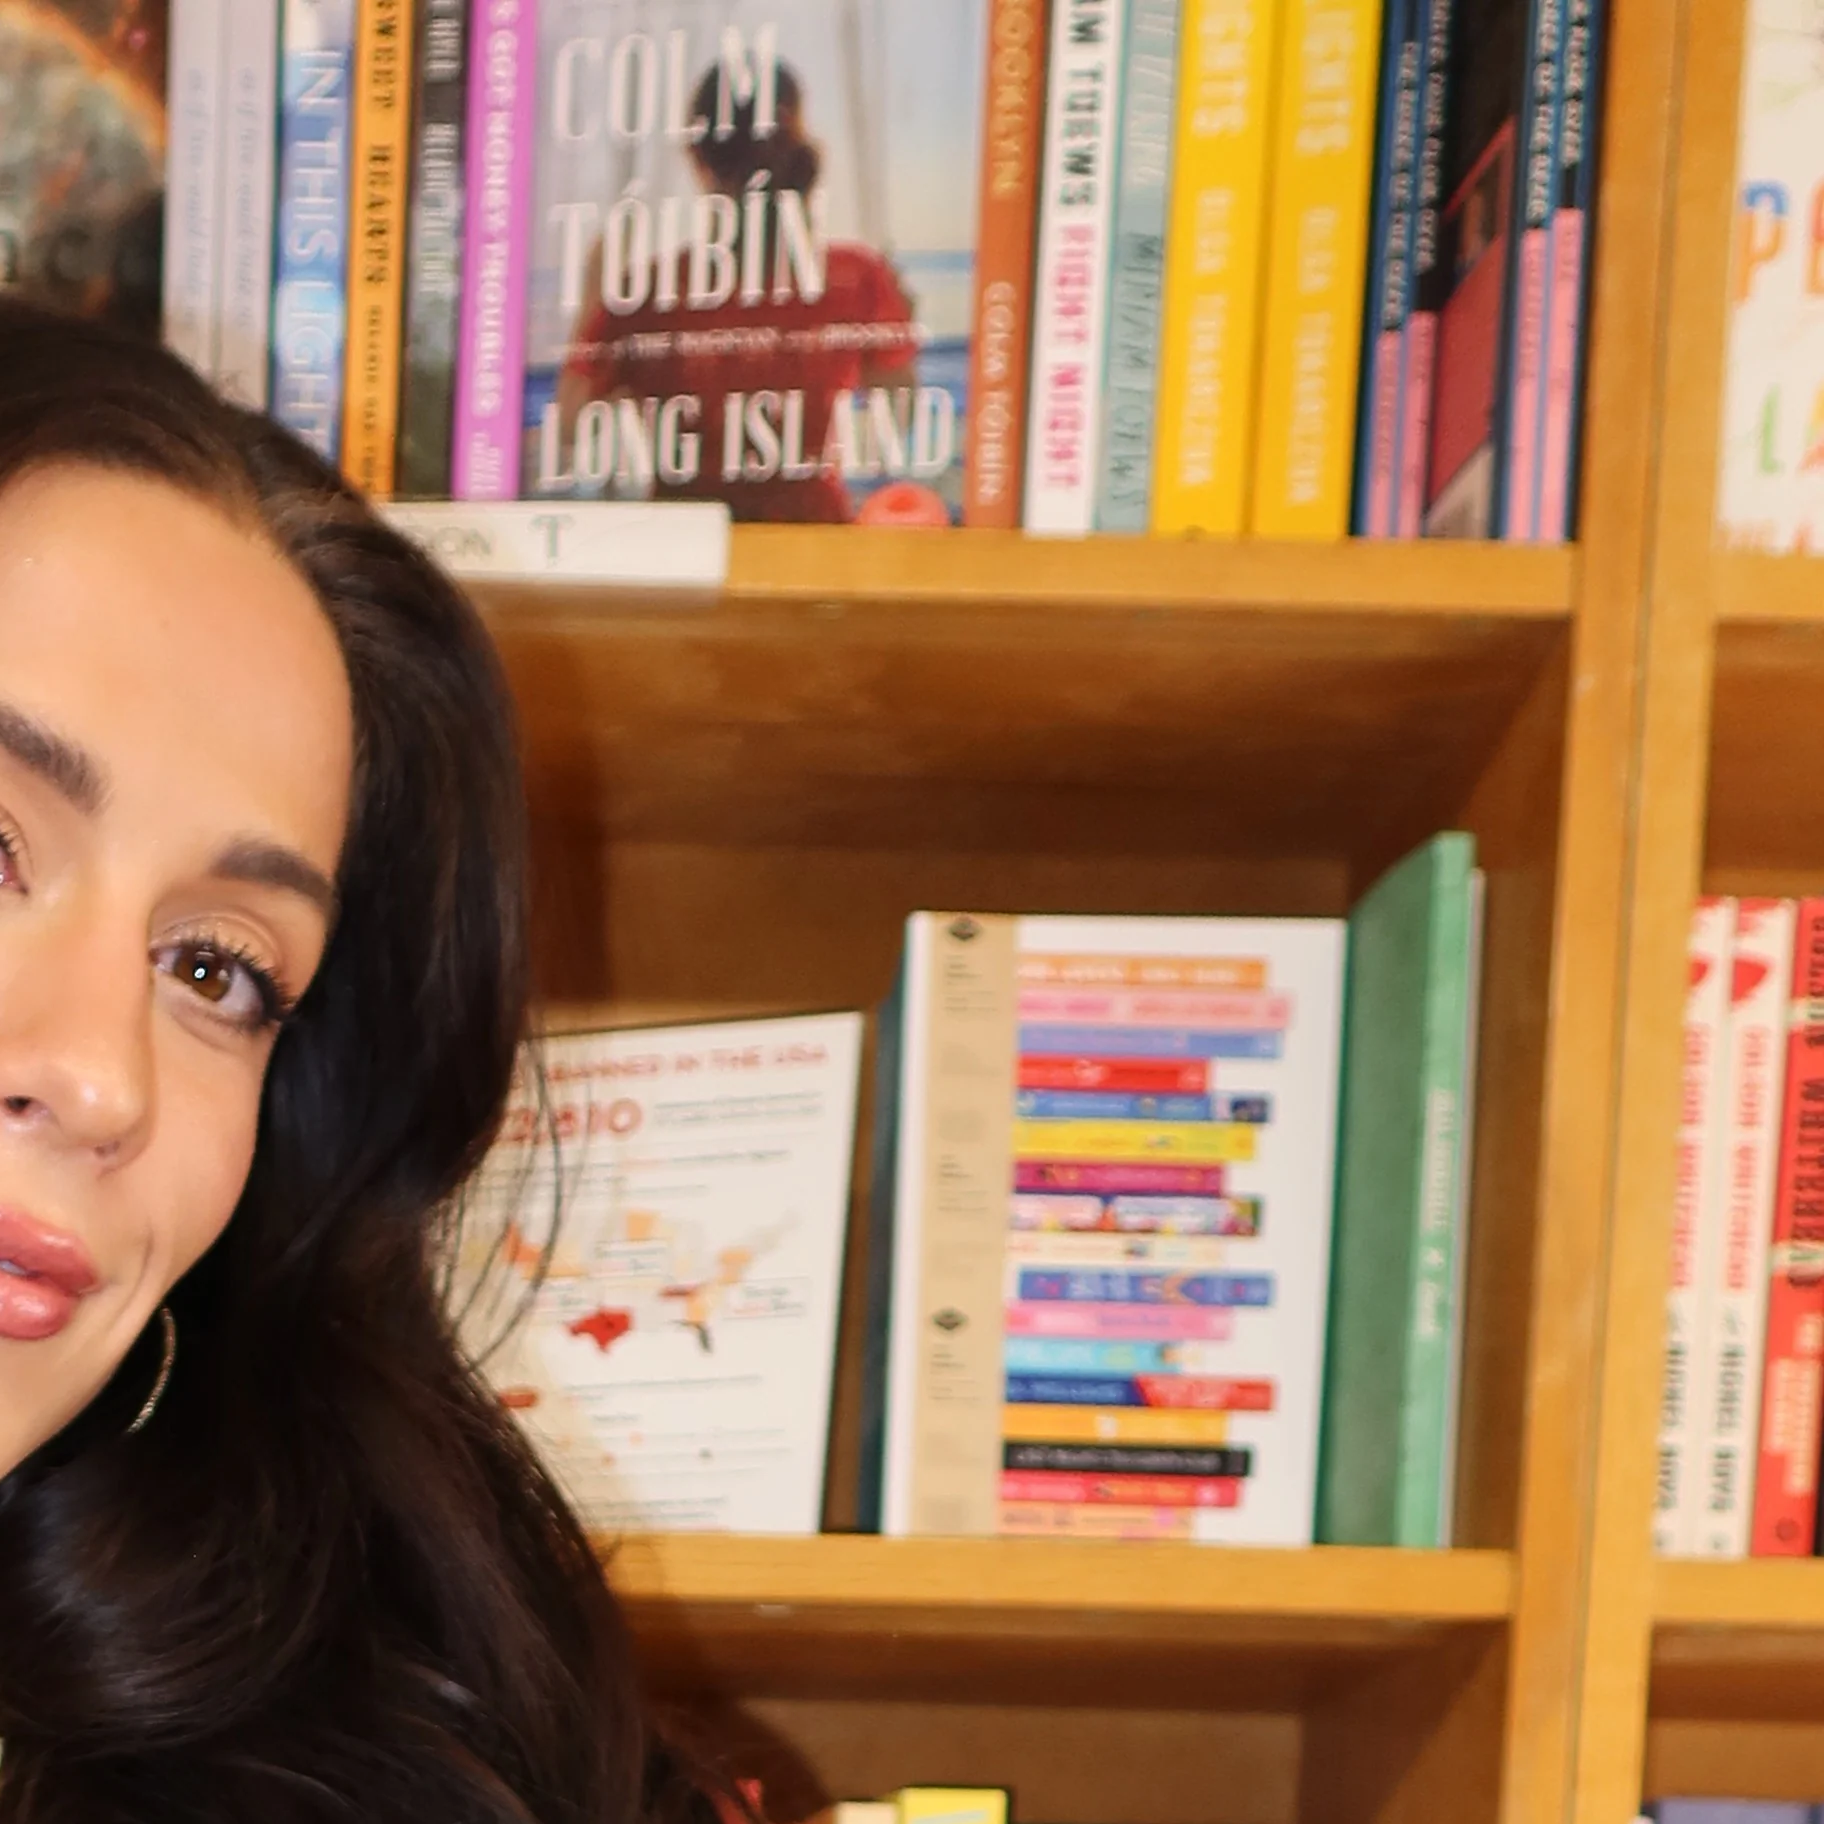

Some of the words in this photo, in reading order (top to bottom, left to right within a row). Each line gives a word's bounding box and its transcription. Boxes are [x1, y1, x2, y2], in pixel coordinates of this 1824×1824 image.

[297, 50, 344, 110] IN
[551, 22, 779, 147] COLM
[990, 0, 1033, 200] OOKLYN
[1060, 66, 1106, 208] TOEWS
[288, 128, 342, 262] THIS
[366, 145, 393, 287] HEARTS
[482, 112, 516, 232] MONEY
[546, 168, 828, 317] TÓIBÍN
[1053, 224, 1095, 344] FIGHT
[285, 279, 336, 453] LIGHT
[1047, 361, 1088, 490] NIGHT
[540, 392, 701, 494] LONG
[723, 386, 955, 483] ISLAND
